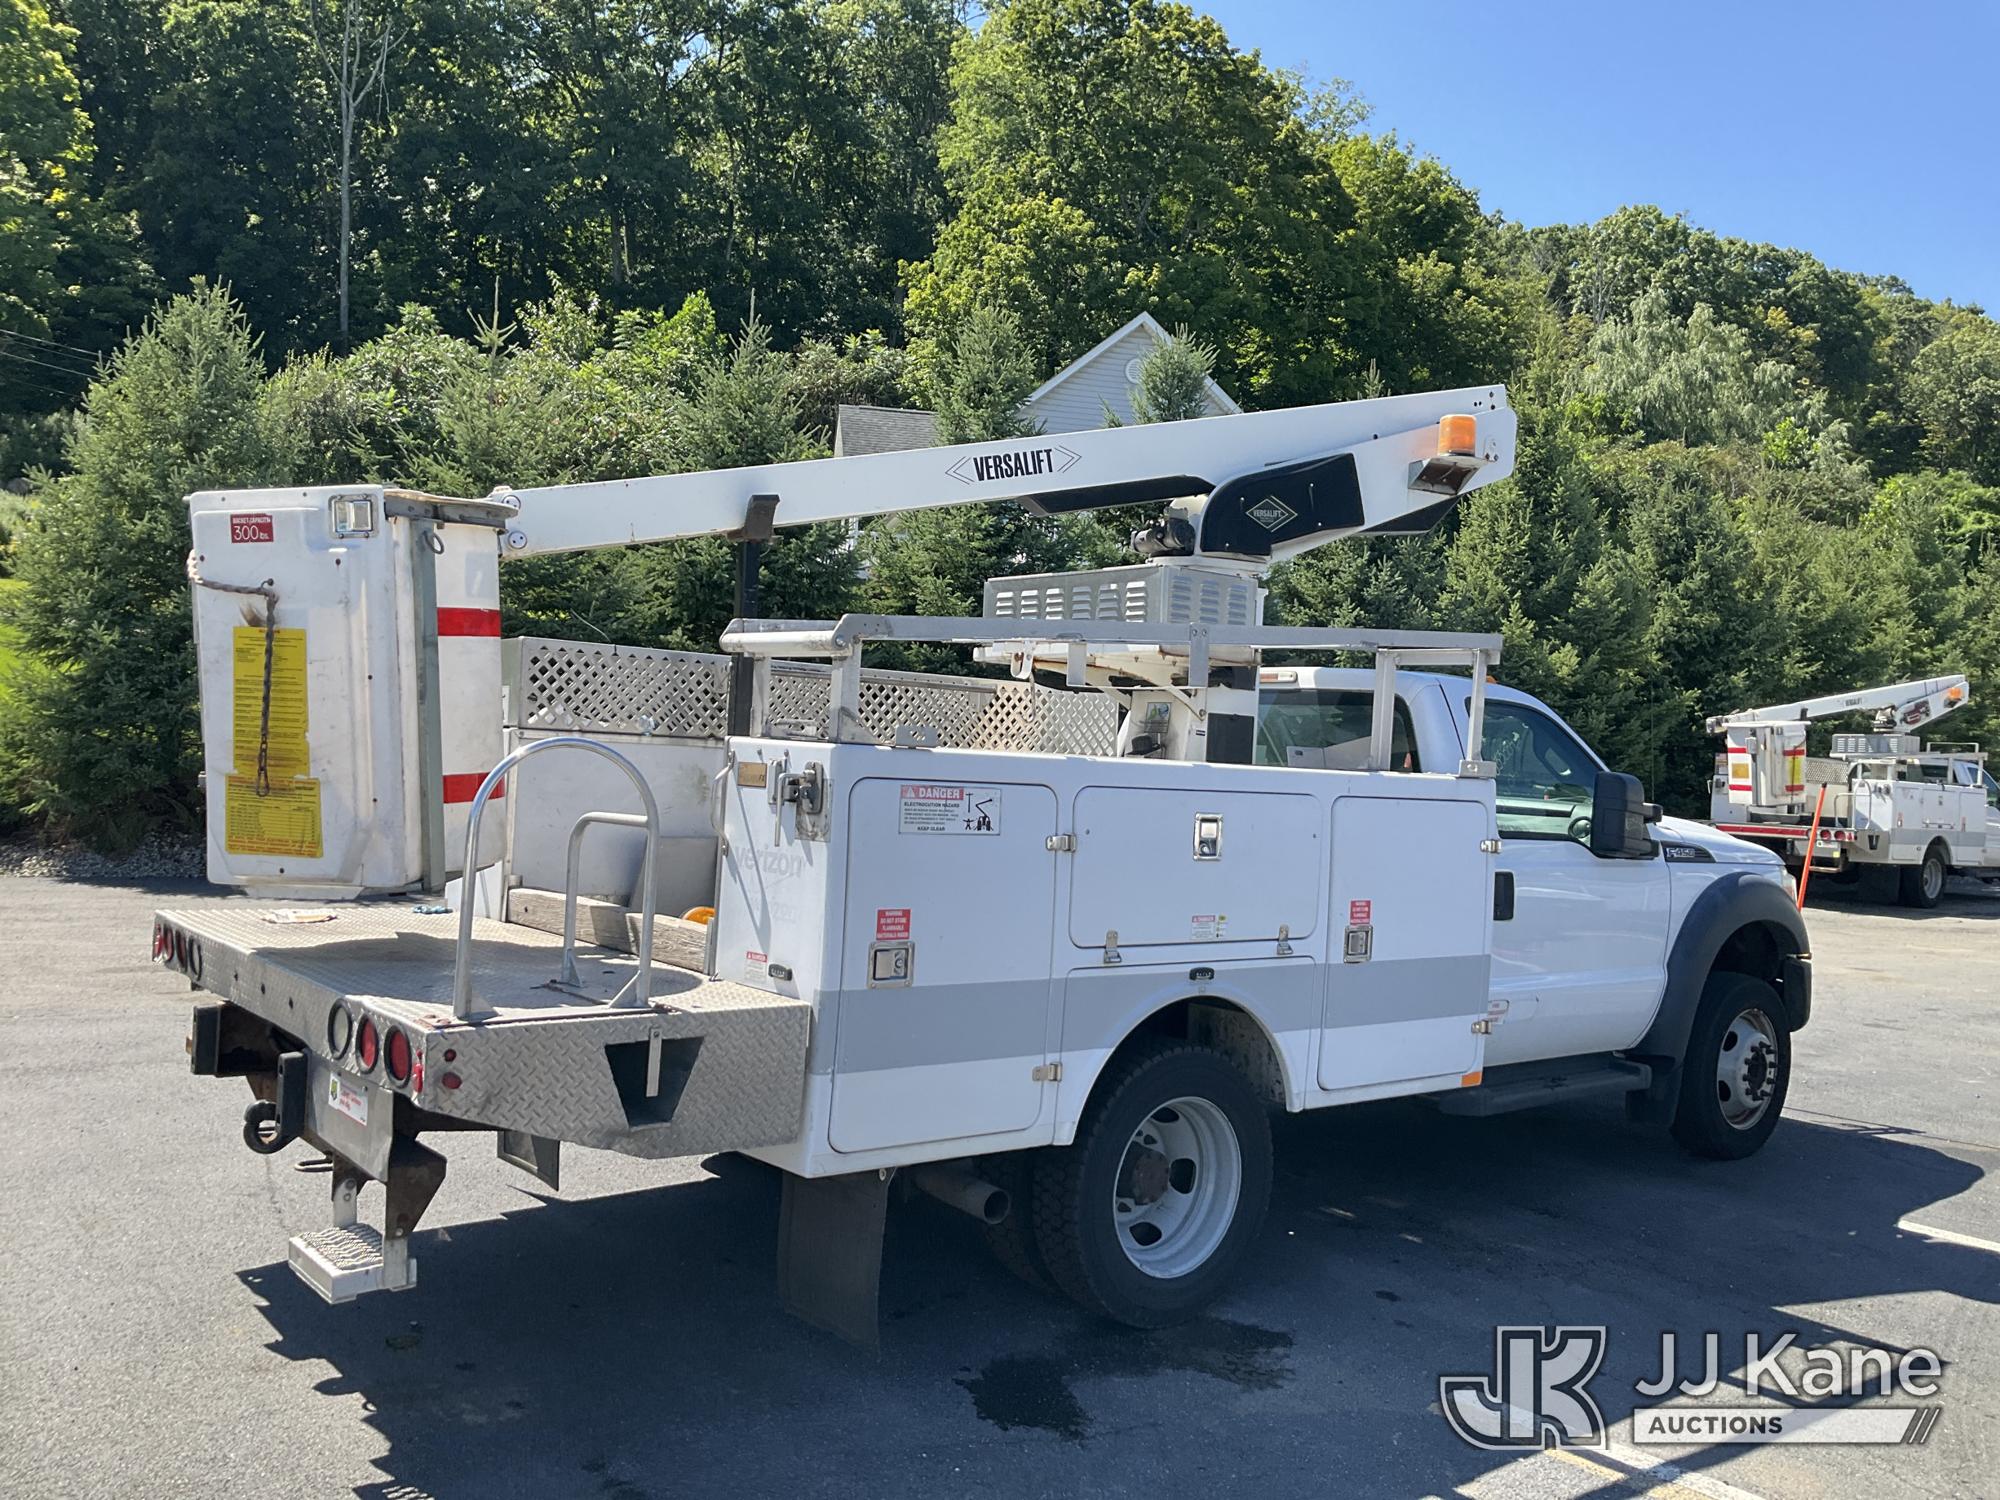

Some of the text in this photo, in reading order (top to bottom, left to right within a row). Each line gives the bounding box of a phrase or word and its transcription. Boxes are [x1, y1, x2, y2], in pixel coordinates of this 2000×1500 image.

[973, 449, 1053, 481] VERSALIFT
[1253, 509, 1282, 518] VERSALIFT
[233, 525, 259, 541] 300
[918, 787, 960, 800] DANGER
